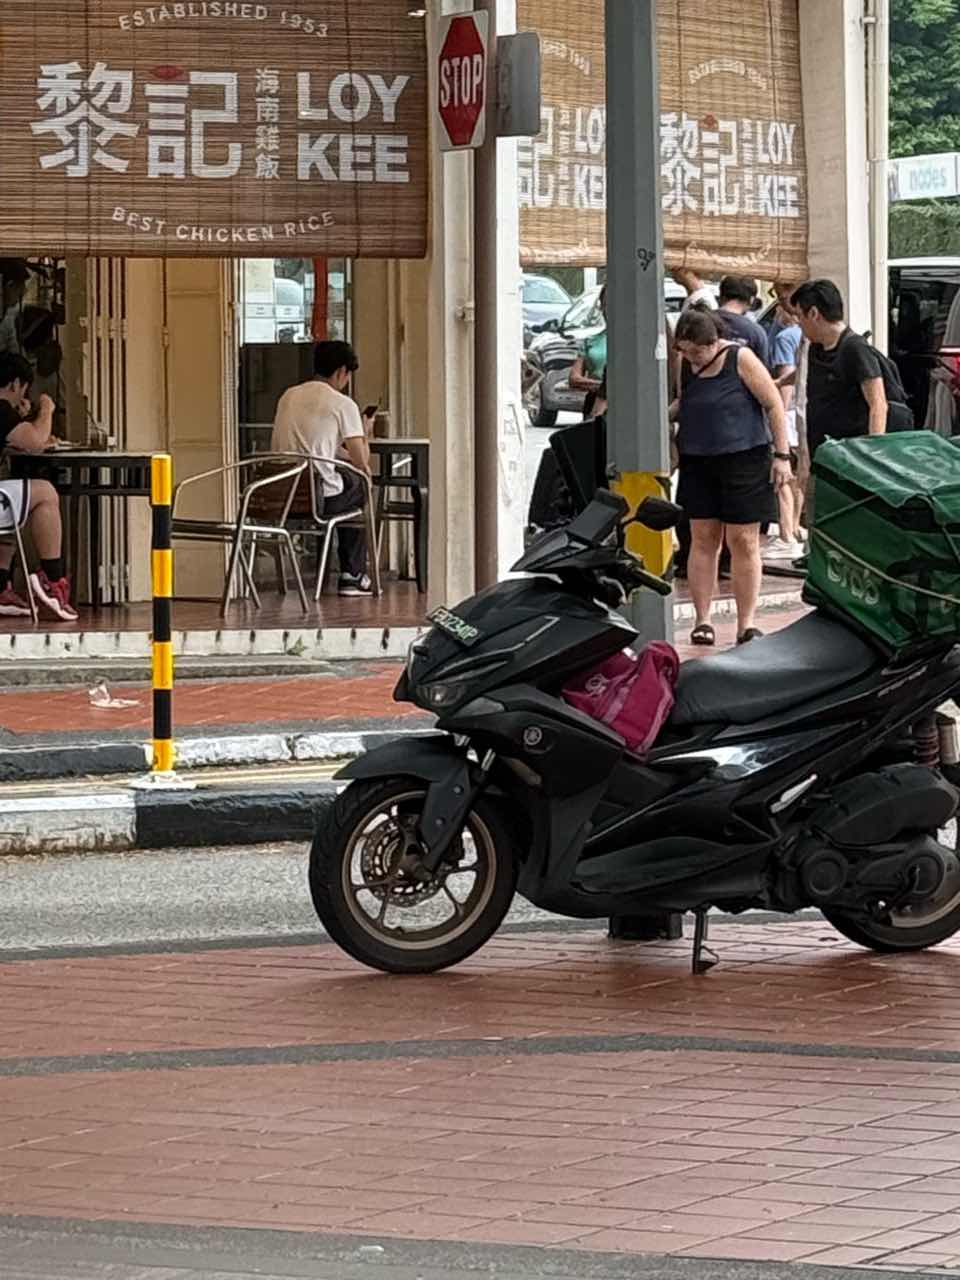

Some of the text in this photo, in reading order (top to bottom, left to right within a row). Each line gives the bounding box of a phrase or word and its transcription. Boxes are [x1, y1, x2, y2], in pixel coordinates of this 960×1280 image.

[118, 1, 329, 38] ESTABLISHED 1953
[296, 71, 410, 122] LOY
[440, 54, 482, 108] STOP
[31, 62, 241, 179] 黎記
[575, 106, 606, 154] LO
[757, 121, 797, 165] LOY
[297, 134, 410, 182] KEE
[575, 163, 606, 208] KE
[757, 175, 800, 217] KEE
[112, 206, 336, 242] BEST CHICKEN RICE
